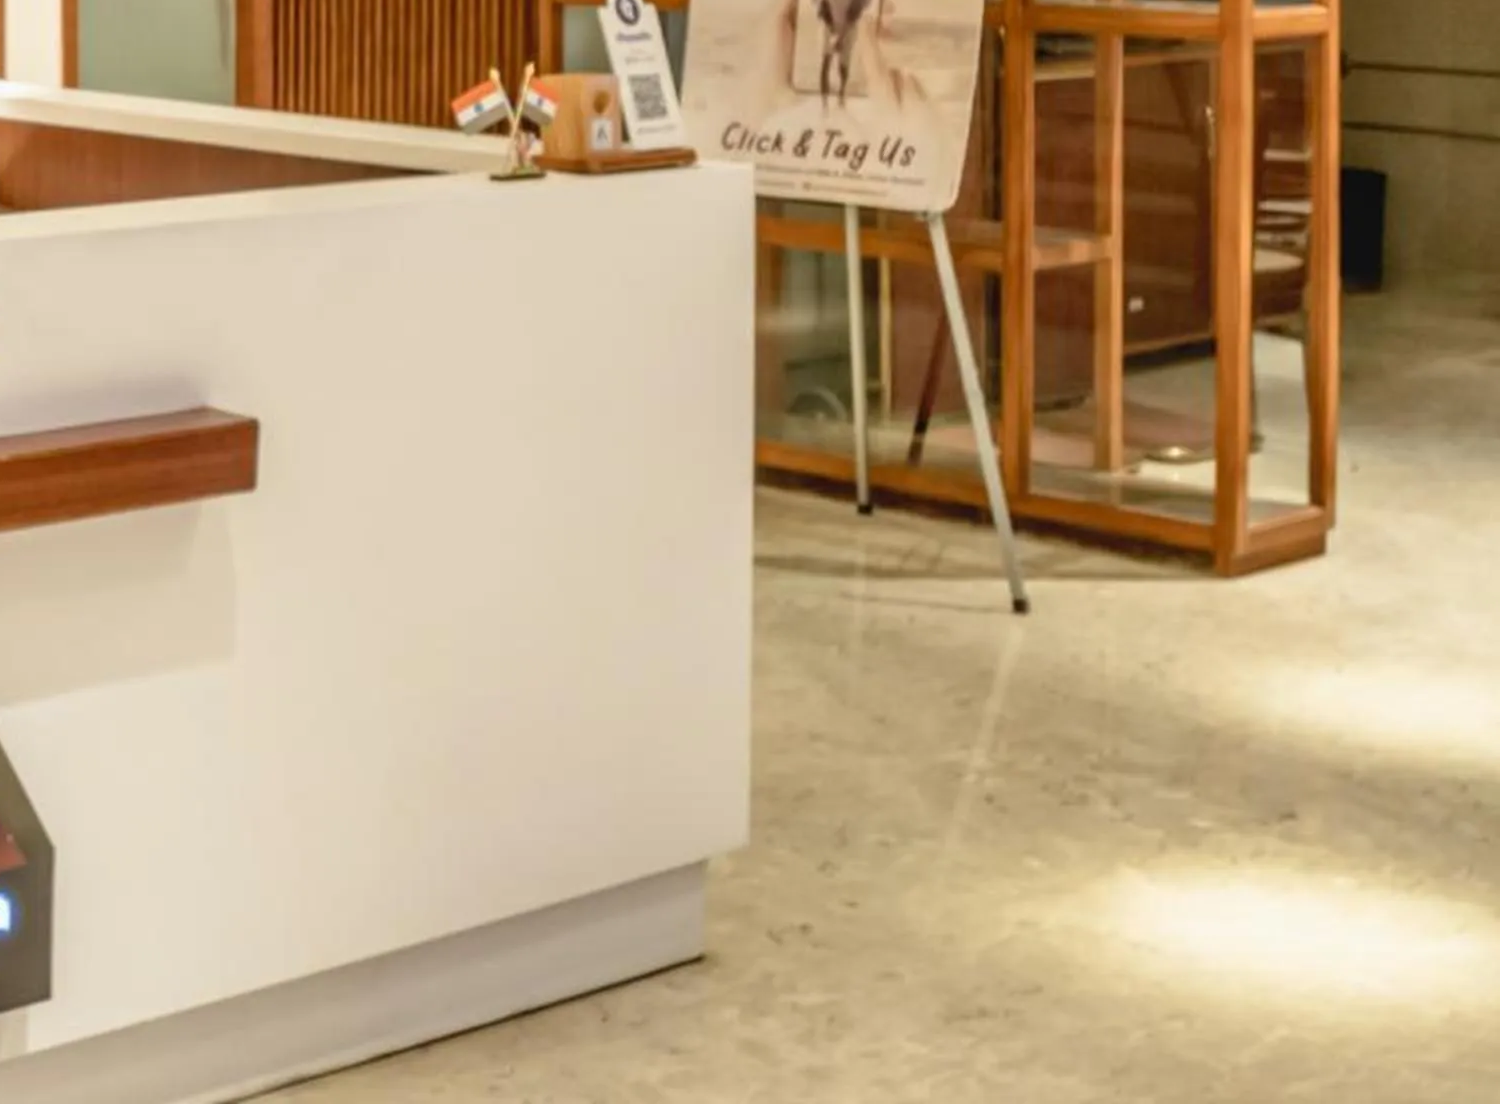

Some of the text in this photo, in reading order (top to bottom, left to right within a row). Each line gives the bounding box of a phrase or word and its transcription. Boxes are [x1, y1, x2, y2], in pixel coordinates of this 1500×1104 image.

[720, 121, 917, 171] Click & Tag Us
